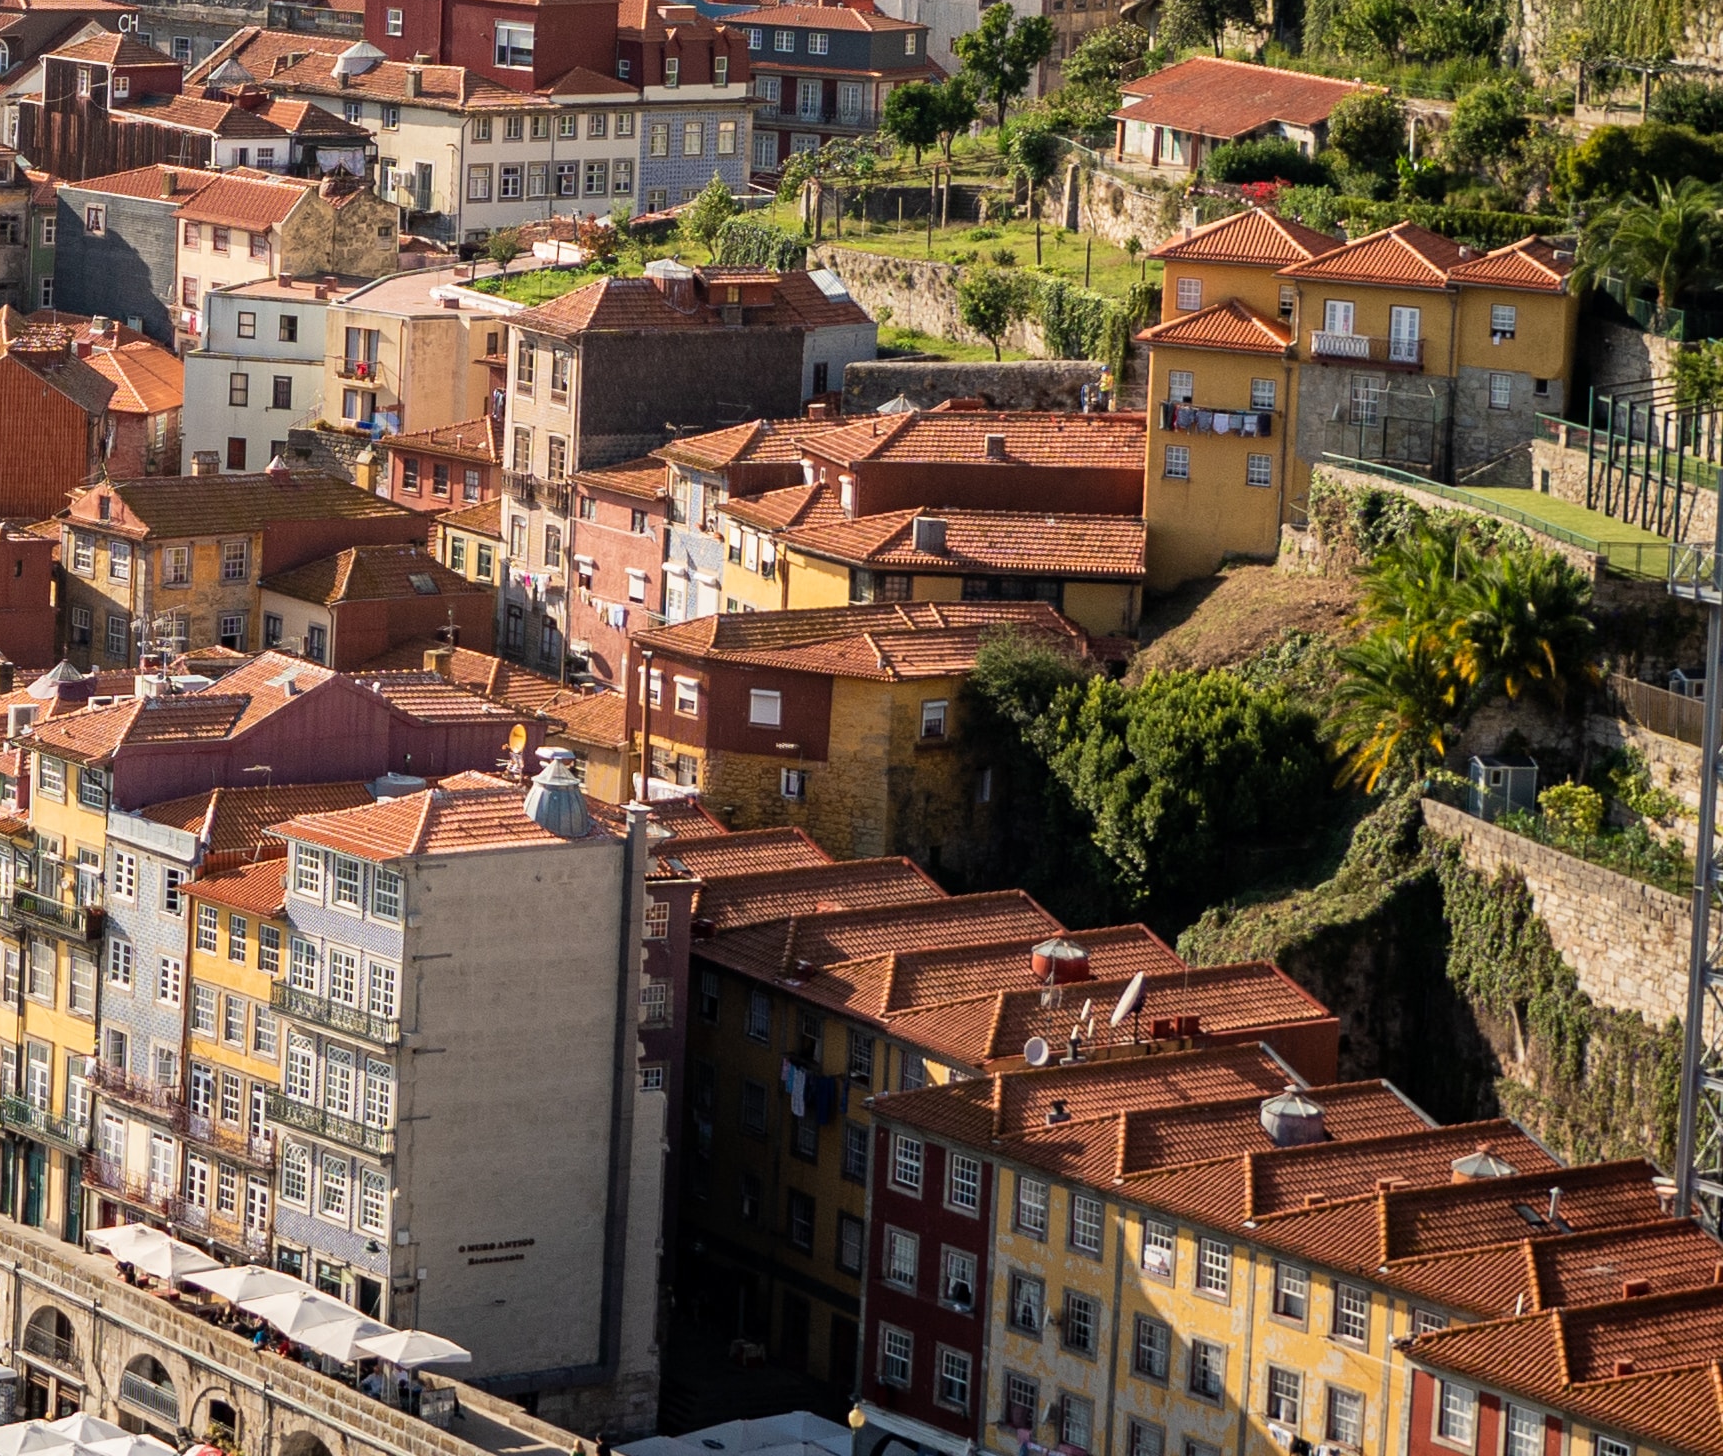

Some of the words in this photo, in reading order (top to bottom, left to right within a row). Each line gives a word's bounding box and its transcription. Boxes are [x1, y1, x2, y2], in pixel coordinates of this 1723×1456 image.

[118, 13, 139, 33] CH
[458, 1245, 466, 1253] O
[467, 1242, 496, 1252] MURO
[497, 1238, 535, 1250] ANTIGO
[468, 1253, 525, 1266] Restaurante
